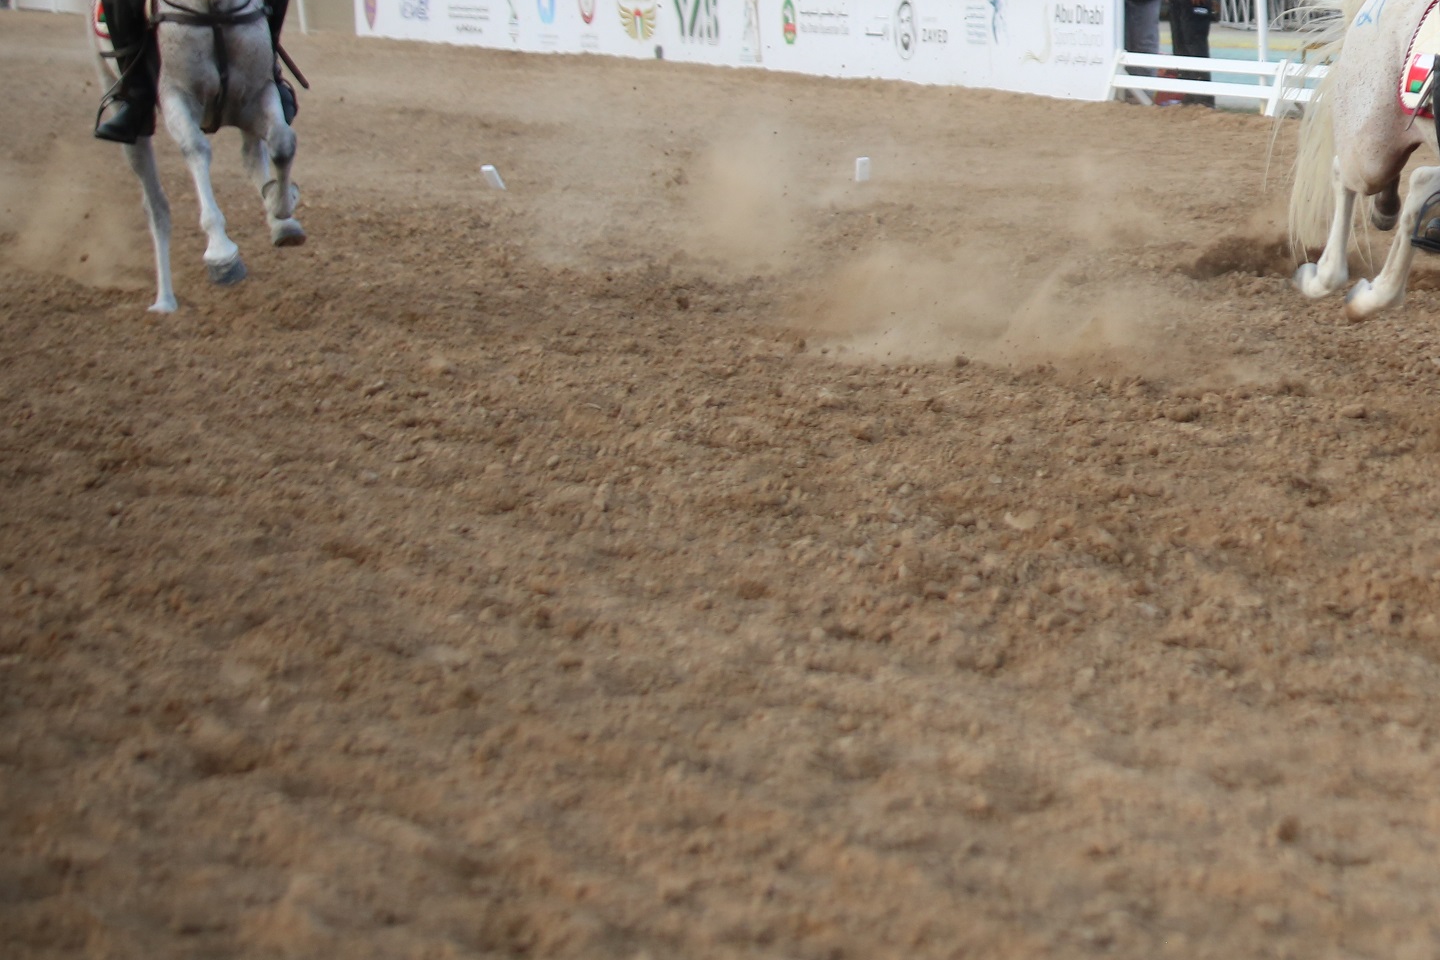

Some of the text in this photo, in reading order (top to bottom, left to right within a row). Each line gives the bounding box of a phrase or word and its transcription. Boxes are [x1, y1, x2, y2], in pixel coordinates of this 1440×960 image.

[1054, 3, 1104, 26] Abu Dhabi
[922, 28, 948, 43] ZAYED
